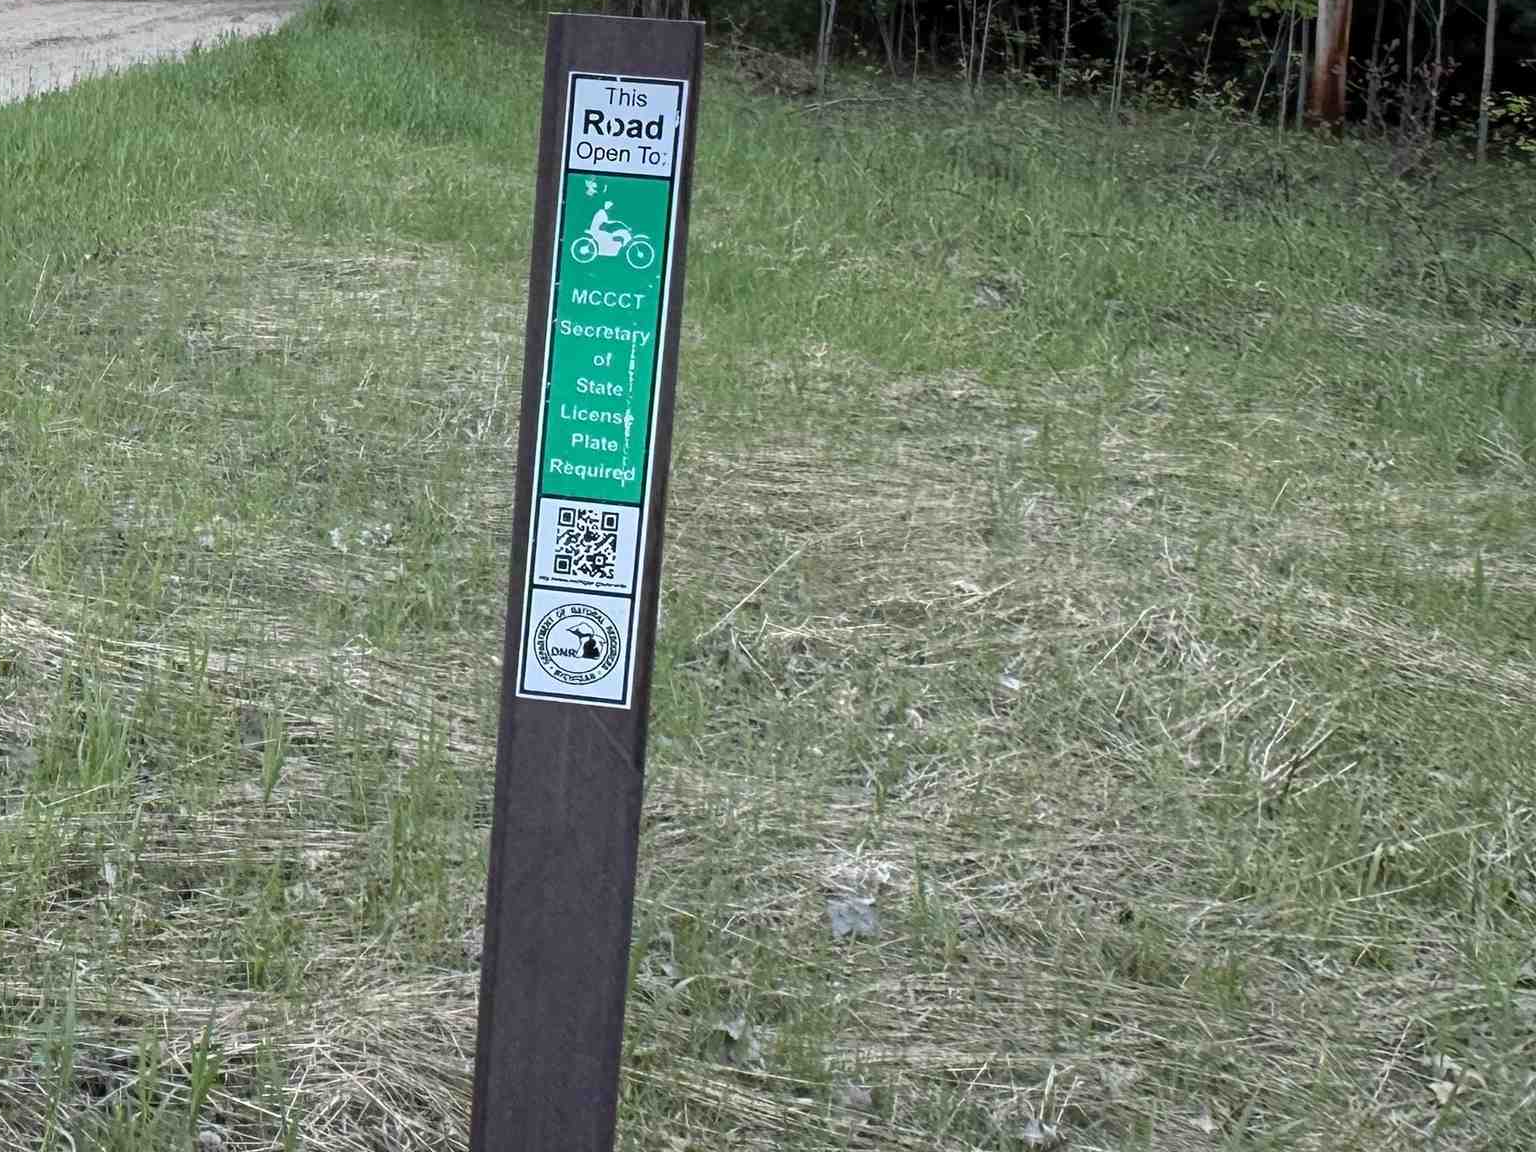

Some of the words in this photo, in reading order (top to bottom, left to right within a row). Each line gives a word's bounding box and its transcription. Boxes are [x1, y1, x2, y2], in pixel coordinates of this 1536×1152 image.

[606, 87, 648, 107] This
[583, 109, 664, 140] Road
[576, 141, 631, 164] Open
[571, 288, 646, 310] MCCCT
[560, 320, 650, 346] Secretary
[593, 352, 613, 367] of
[576, 377, 624, 397] State
[560, 404, 634, 425] License
[571, 433, 618, 452] Plate
[549, 458, 635, 481] Required
[551, 646, 577, 658] DNR
